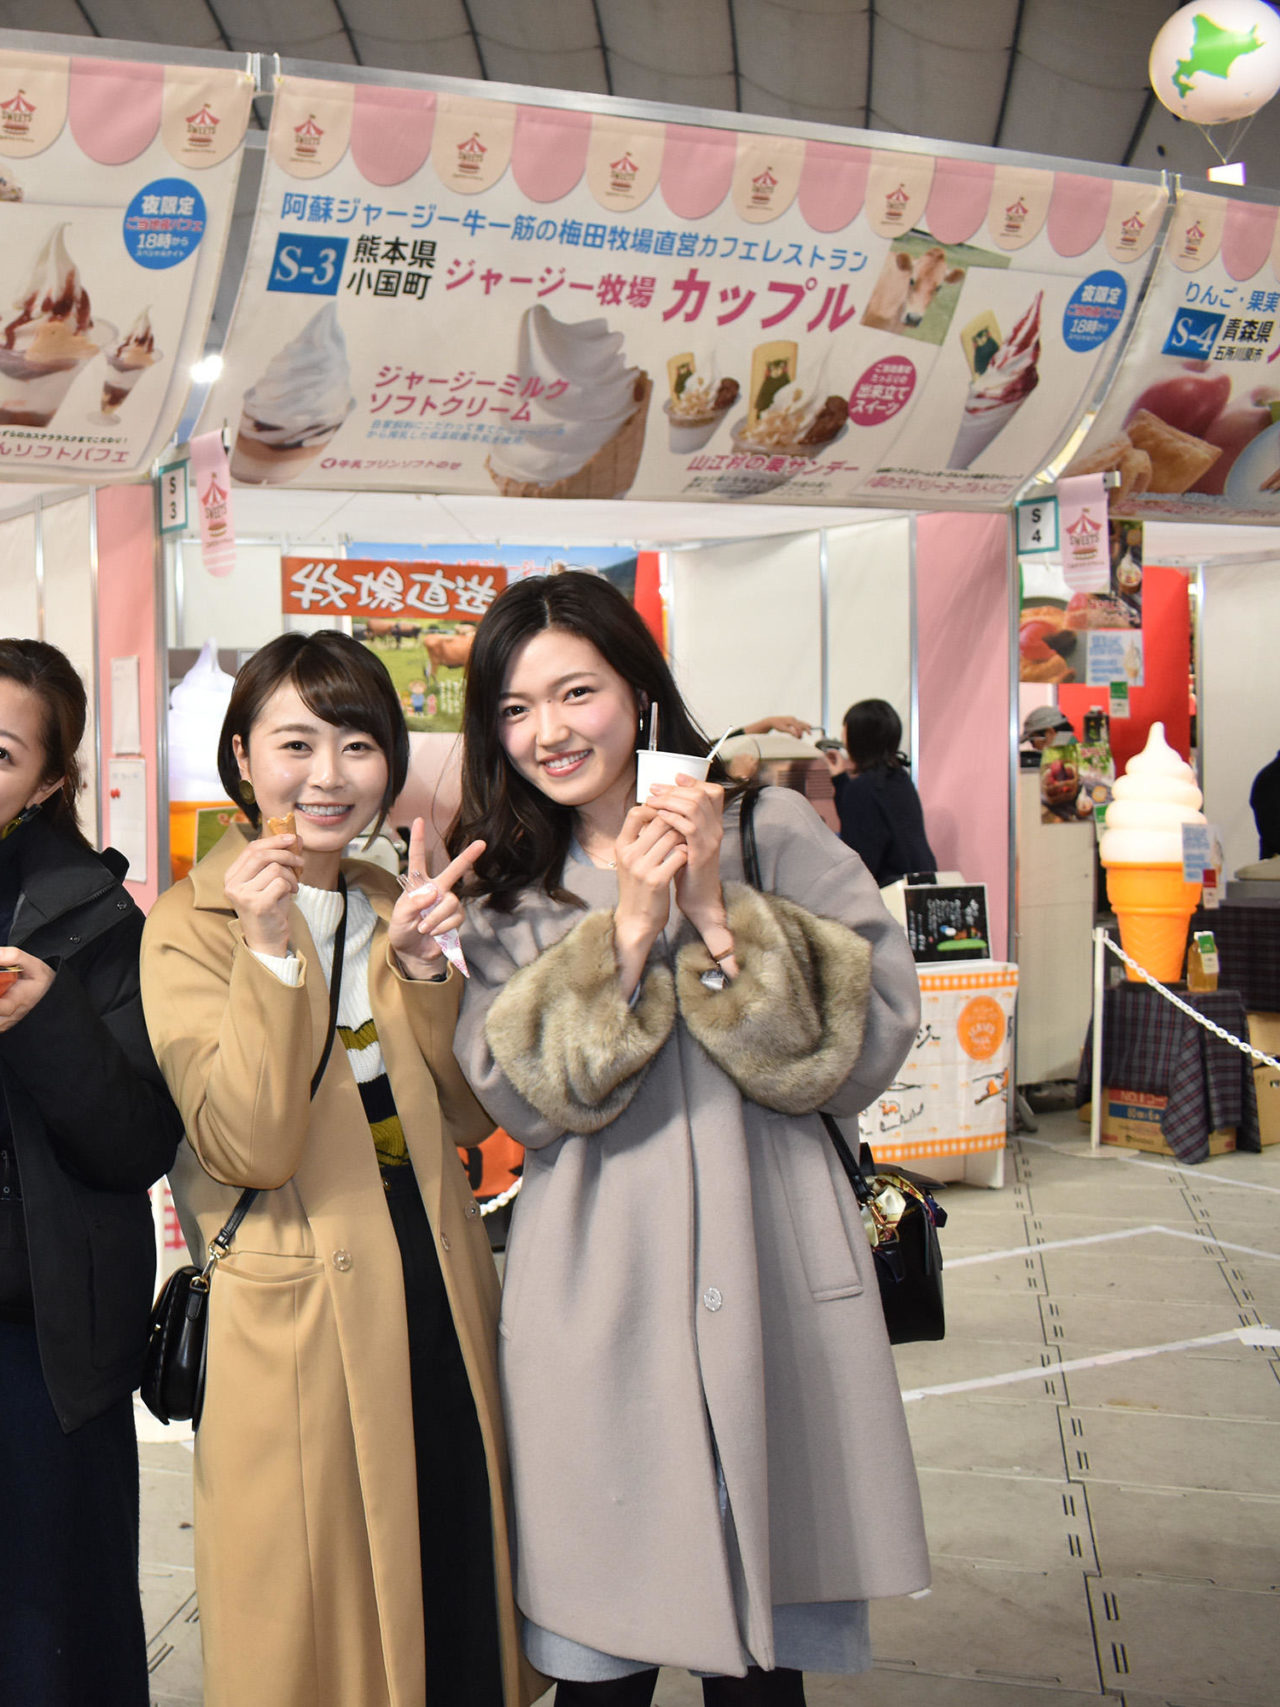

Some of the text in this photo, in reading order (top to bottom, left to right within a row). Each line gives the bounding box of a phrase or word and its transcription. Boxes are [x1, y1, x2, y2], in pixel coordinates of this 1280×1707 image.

[142, 195, 195, 215] 夜限定
[281, 192, 869, 272] 阿蘇ジャージー牛一筋の梅田牧場直営カフェレストラン
[274, 246, 338, 285] S-3
[353, 234, 437, 269] 熊本県
[347, 268, 432, 300] 小国町
[446, 258, 856, 332] ジャージー牧場 カップル
[1172, 317, 1217, 352] S-4
[1222, 318, 1274, 343] 青森県
[375, 366, 571, 400] ジャージーミルク
[370, 392, 532, 422] ソフトクリーム
[850, 400, 899, 415] スイーツ
[169, 476, 177, 495] S
[170, 501, 177, 519] 3
[1031, 508, 1041, 523] S
[1031, 529, 1042, 543] 4
[291, 562, 498, 614] 牧場直送
